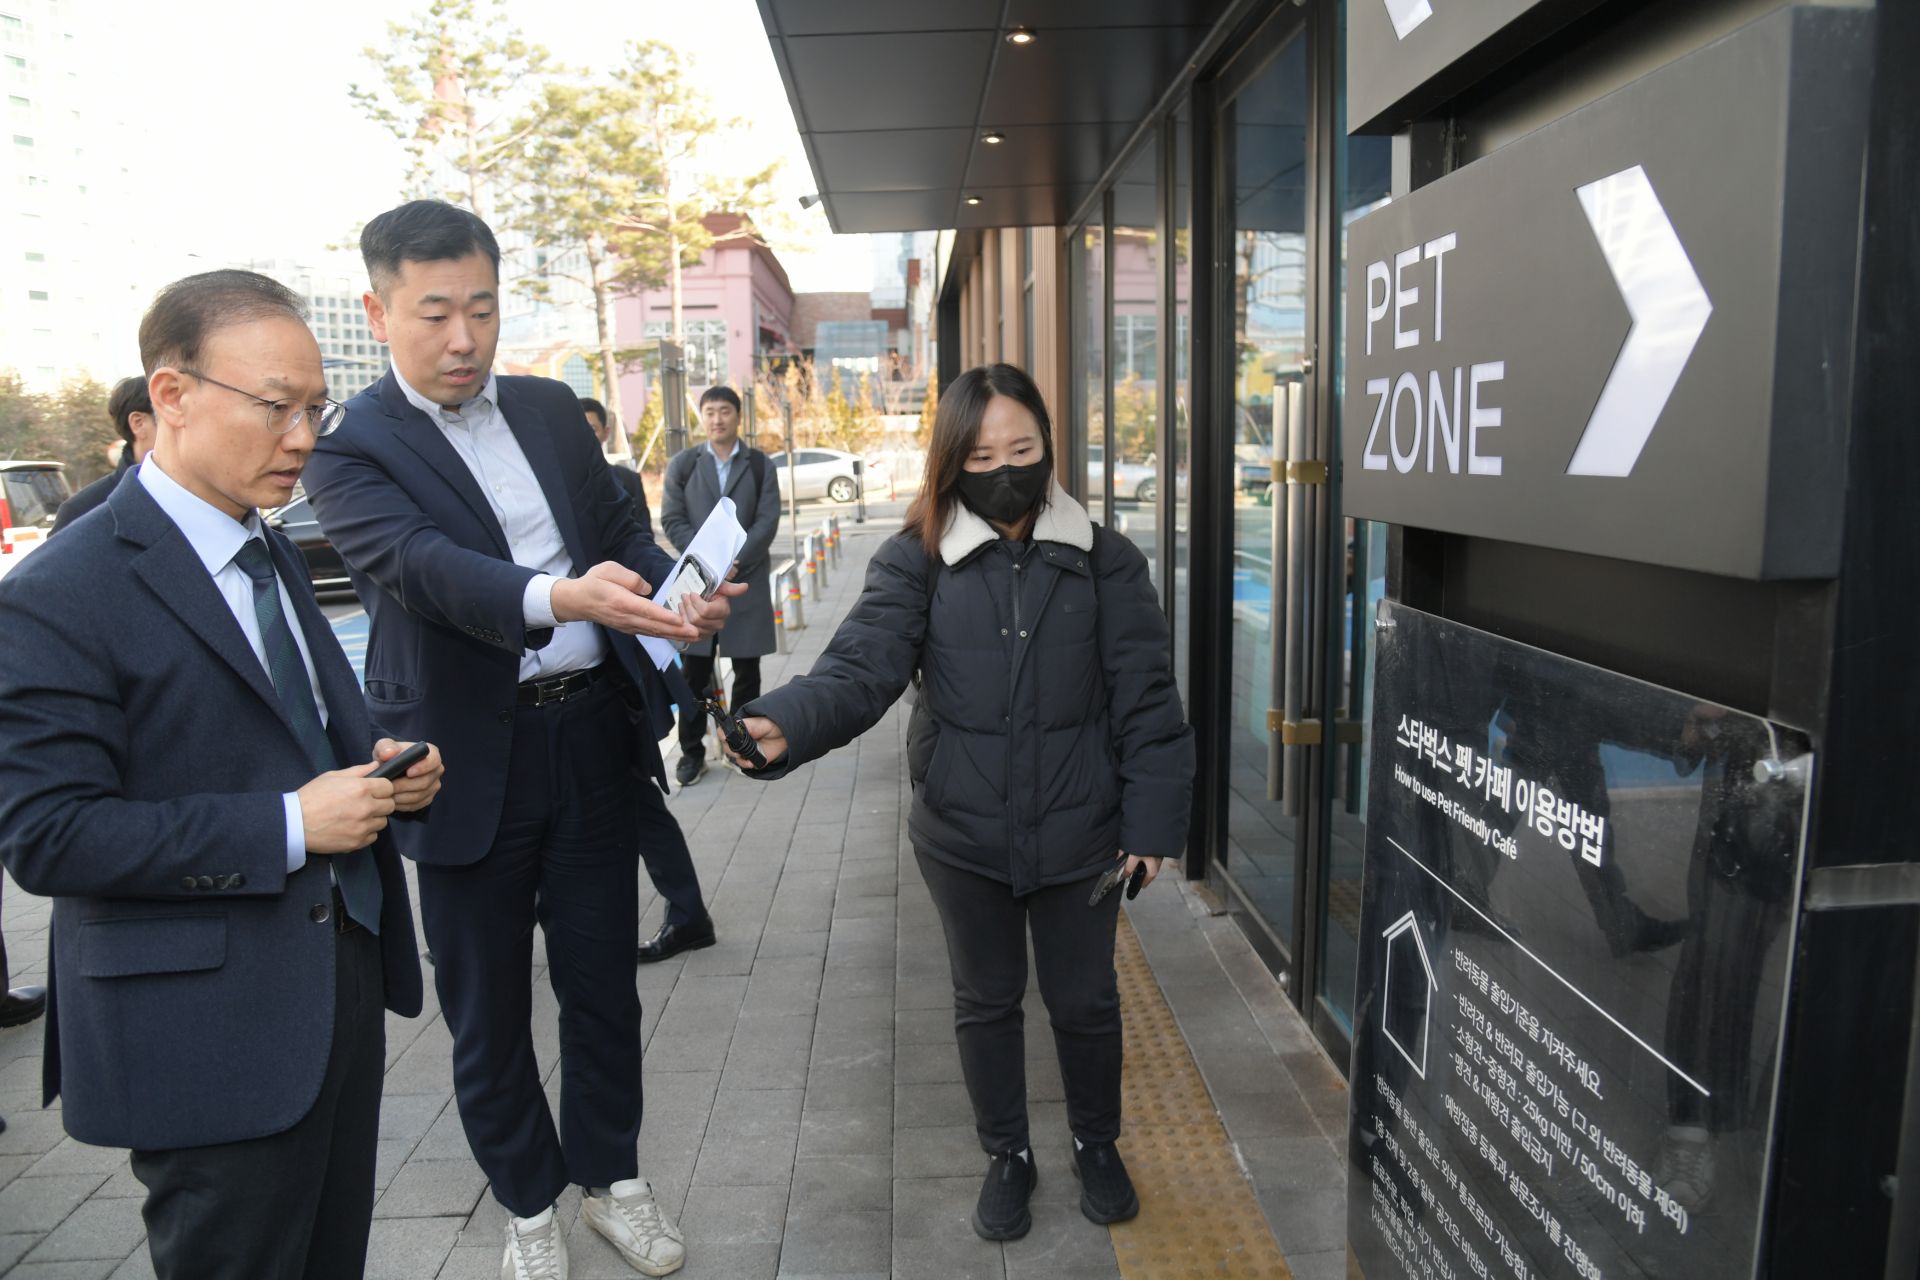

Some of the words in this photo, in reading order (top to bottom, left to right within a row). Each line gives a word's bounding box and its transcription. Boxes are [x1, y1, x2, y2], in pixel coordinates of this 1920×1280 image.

[1366, 232, 1456, 356] PET
[1362, 360, 1505, 476] ZONE
[1394, 763, 1412, 788] How
[1412, 777, 1421, 795] to
[1421, 785, 1437, 806] use
[1437, 792, 1452, 817] Pet
[1452, 803, 1491, 846] Friendly
[1492, 829, 1518, 860] Café
[1397, 714, 1452, 773] 스타벅스
[1455, 744, 1472, 789] 펫
[1474, 756, 1512, 813] 카페
[1516, 778, 1605, 867] 이용방법
[1455, 948, 1488, 995] 반려동물
[1491, 981, 1540, 1043] 출입기준을
[1542, 1027, 1603, 1100] 지켜주세요.
[1375, 1115, 1384, 1139] 1층
[1385, 1129, 1399, 1160] 전체
[1407, 1161, 1420, 1189] 2층
[1421, 1178, 1435, 1209] 일부
[1436, 1201, 1460, 1247] 공간은
[1377, 1073, 1402, 1119] 반려동물
[1403, 1108, 1418, 1139] 동반
[1418, 1128, 1440, 1170] 출입은
[1441, 1159, 1458, 1190] 외부
[1459, 1181, 1494, 1241] 통로로만
[1445, 1094, 1479, 1146] 예방접종
[1479, 1134, 1508, 1182] 등록과
[1509, 1170, 1562, 1247] 설문조사를
[1455, 1053, 1472, 1086] 맹견
[1473, 1074, 1480, 1095] &
[1481, 1083, 1509, 1128] 대형견
[1511, 1115, 1553, 1177] 출입금지
[1456, 1026, 1516, 1101] 소형견~중형견
[1523, 1095, 1549, 1137] 25kg
[1550, 1122, 1572, 1160] 미만
[1572, 1147, 1580, 1166] /
[1580, 1153, 1616, 1204] 50cm
[1618, 1192, 1646, 1235] 이하
[1459, 993, 1484, 1034] 반려견
[1486, 1021, 1493, 1043] &
[1495, 1028, 1524, 1072] 반려묘
[1526, 1060, 1569, 1118] 출입가능
[1572, 1108, 1587, 1135] (그
[1589, 1125, 1601, 1150] 외
[1603, 1136, 1653, 1200] 반려동물
[1654, 1186, 1688, 1235] 제외)
